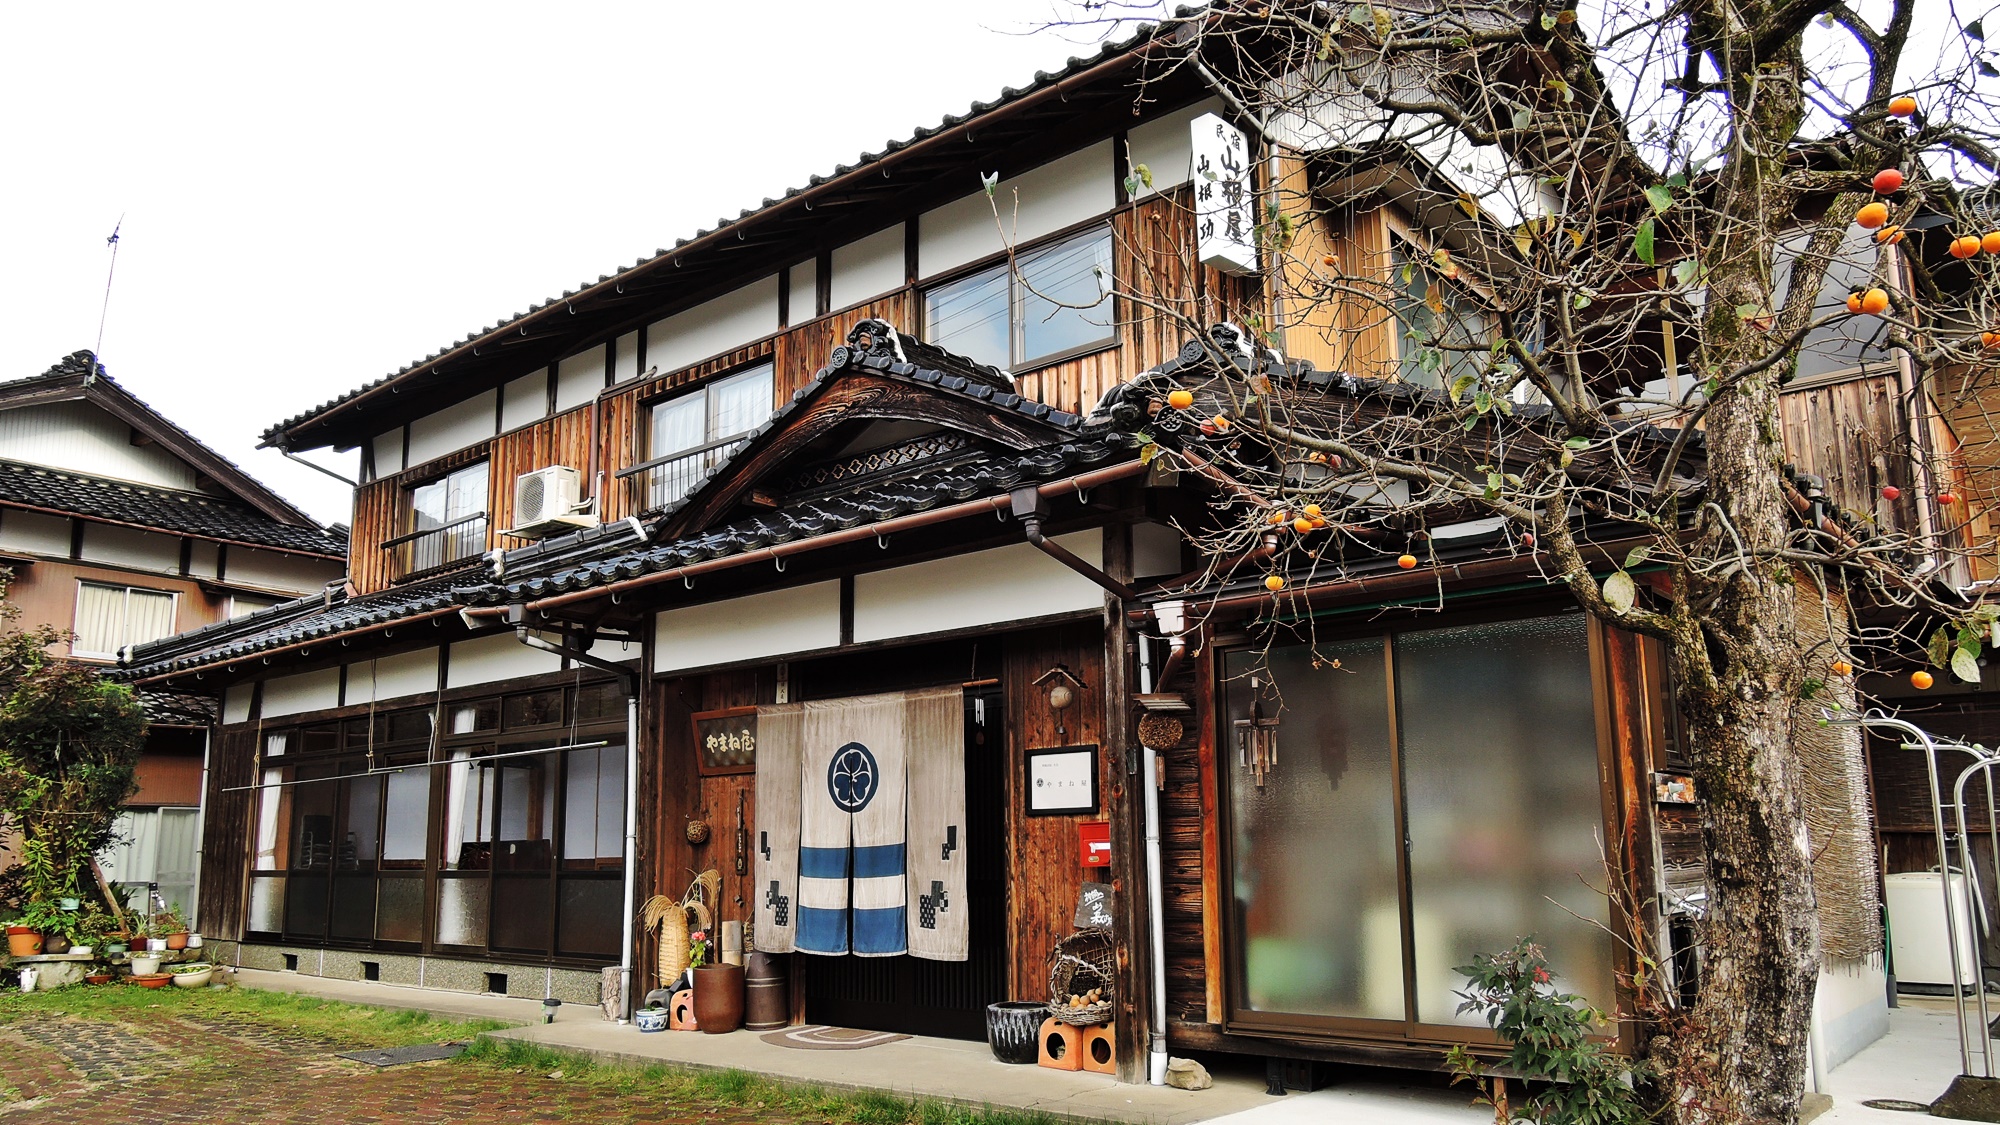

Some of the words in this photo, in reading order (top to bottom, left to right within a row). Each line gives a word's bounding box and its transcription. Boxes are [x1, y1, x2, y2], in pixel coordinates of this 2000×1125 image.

[1216, 124, 1241, 151] 民宿
[1221, 145, 1246, 247] 山根屋
[707, 729, 755, 753] やまね屋
